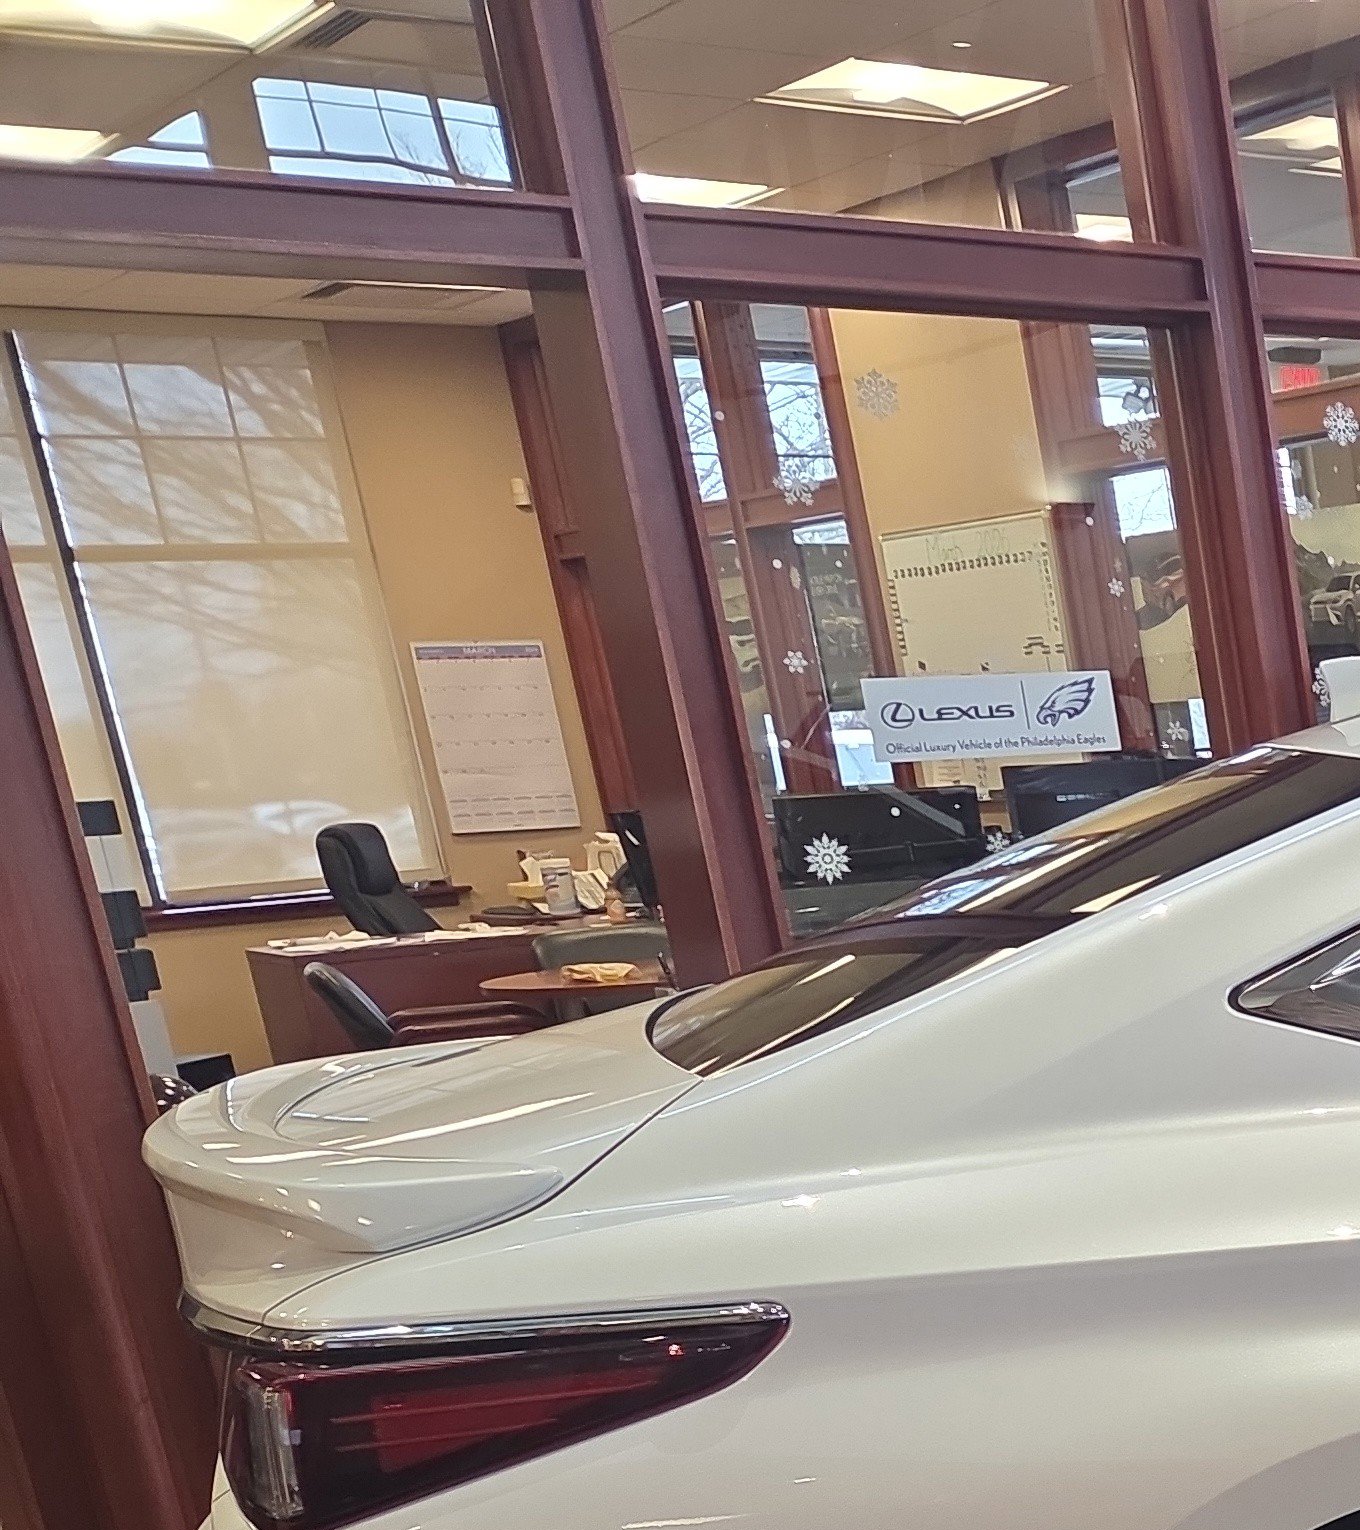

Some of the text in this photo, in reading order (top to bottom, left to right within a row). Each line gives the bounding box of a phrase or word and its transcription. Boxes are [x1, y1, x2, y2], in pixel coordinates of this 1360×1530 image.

[918, 702, 1015, 722] LEXUS
[886, 732, 1106, 754] Official Luxury Vehicle of the Philadelphia Eagles
